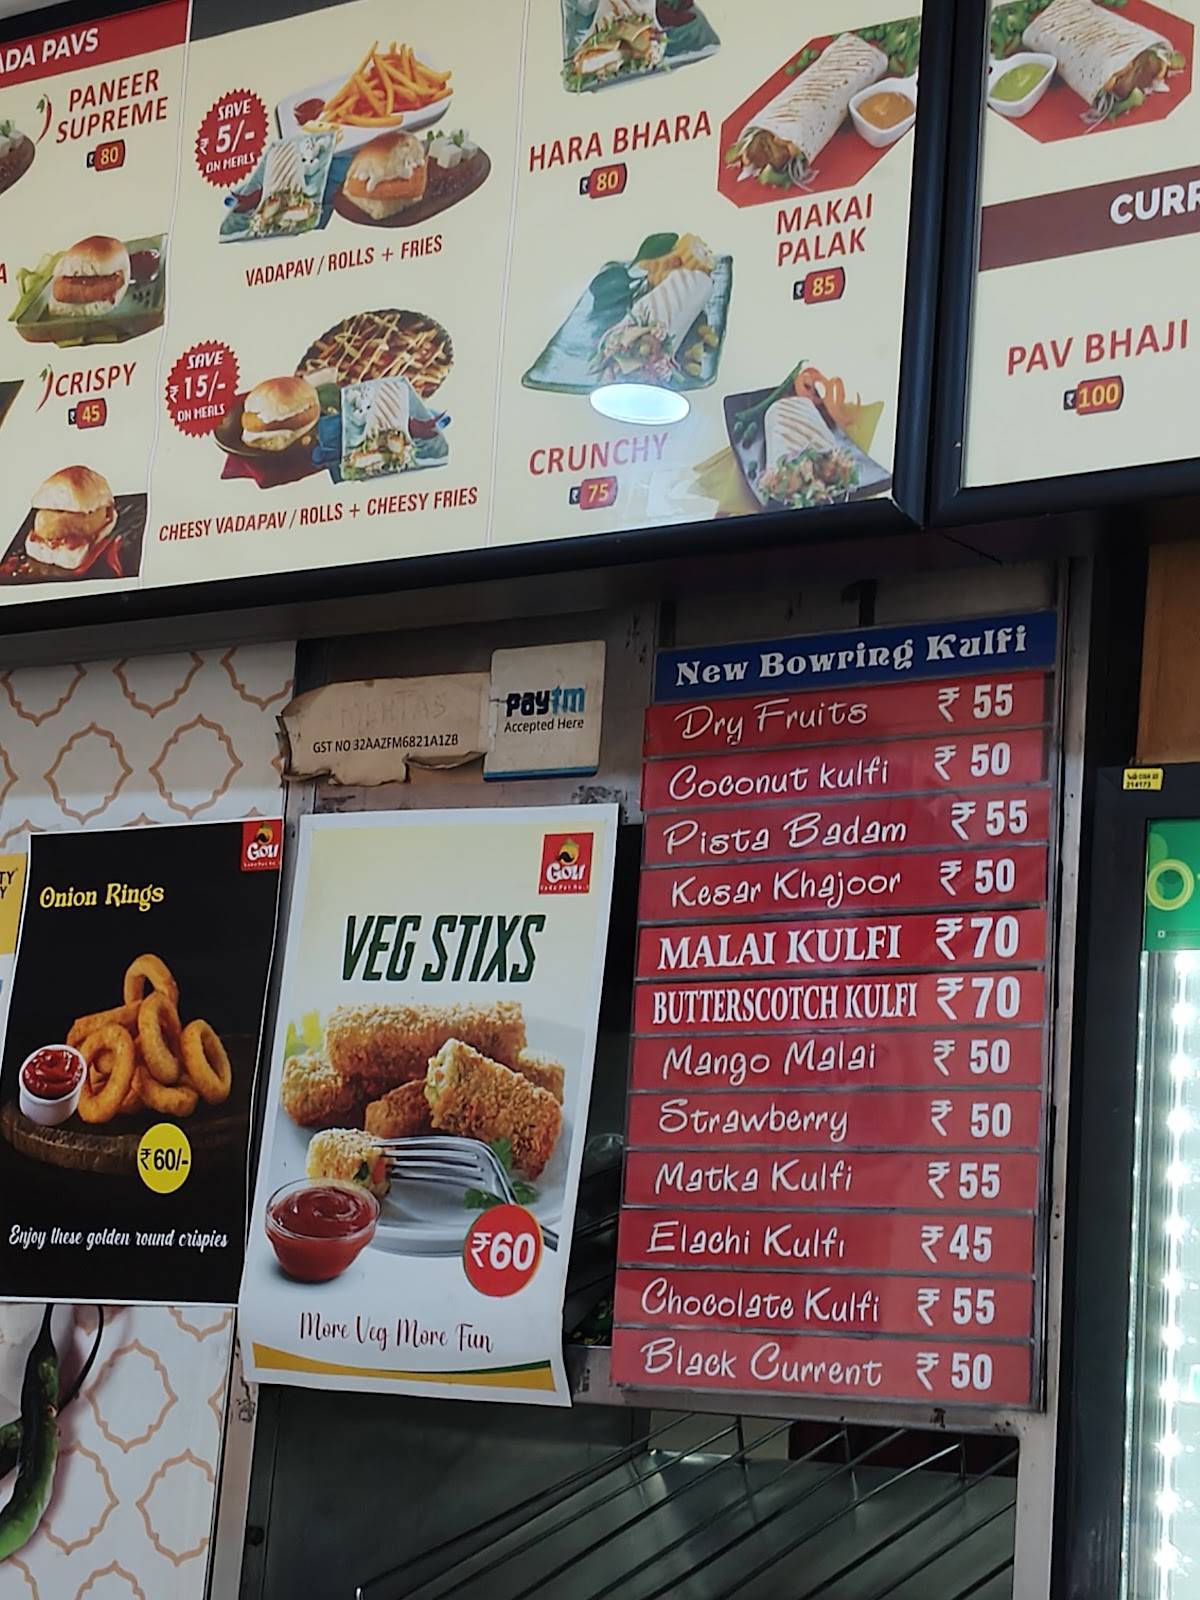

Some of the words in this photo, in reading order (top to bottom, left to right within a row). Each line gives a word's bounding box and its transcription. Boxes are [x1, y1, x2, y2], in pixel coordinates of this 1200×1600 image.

[41, 27, 99, 63] PAVS
[68, 69, 160, 112] PANEER
[217, 98, 252, 121] SAVE
[55, 97, 169, 144] SUPREME
[529, 131, 603, 173] HARA
[612, 110, 712, 154] BHARA
[100, 146, 119, 165] 80
[205, 161, 221, 174] ON
[222, 152, 255, 170] MEALS
[596, 171, 619, 192] 80
[776, 192, 873, 236] MAKAI
[245, 257, 315, 287] VADAPAV
[328, 246, 374, 272] ROLLS
[400, 234, 443, 260] FRIES
[777, 226, 867, 267] PALAK
[812, 275, 836, 297] 85
[186, 350, 224, 370] SAVE
[1007, 337, 1074, 376] PAV
[1085, 318, 1189, 364] BHAJI
[55, 361, 137, 397] CRISPY
[177, 409, 192, 422] ON
[193, 403, 225, 420] MEALS
[529, 432, 669, 476] CRUNCHY
[159, 519, 211, 542] CHEESY
[215, 511, 287, 535] VADAPAV
[300, 502, 343, 526] ROLLS
[367, 493, 429, 516] CHEESY
[433, 486, 479, 510] FRIES
[587, 482, 609, 503] 75
[675, 661, 749, 687] New
[759, 638, 914, 679] Bowring
[926, 624, 1027, 661] Kulfi
[505, 685, 586, 718] paytm
[674, 704, 744, 746] Dry
[753, 698, 868, 733] Fruits
[973, 683, 1014, 720] 55
[503, 713, 554, 735] Accepted
[556, 713, 585, 730] Here
[312, 740, 332, 754] GST
[335, 738, 351, 752] NO
[668, 764, 808, 802] Coconut
[819, 756, 889, 788] kulfi
[970, 742, 1011, 778] 50
[663, 819, 770, 856] Pista
[782, 811, 907, 850] Badam
[985, 799, 1029, 836] 55
[39, 886, 97, 909] Onion
[105, 882, 165, 912] Rings
[671, 876, 762, 909] Kesar
[772, 867, 902, 910] Khajoor
[974, 858, 1016, 895] 50
[342, 915, 422, 981] VEG
[421, 914, 546, 982] STIXS
[657, 931, 777, 971] MALAI
[786, 925, 903, 965] KULFI
[652, 984, 839, 1025] BUTTERSCOTCH
[844, 982, 918, 1020] KULFI
[662, 1041, 770, 1087] Mango
[783, 1039, 877, 1076] Malai
[969, 1038, 1011, 1075] 50
[658, 1099, 849, 1143] Strawberry
[970, 1102, 1012, 1139] 50
[654, 1160, 760, 1195] Matka
[771, 1158, 853, 1193] Kulfi
[9, 1224, 47, 1250] Enjoy
[50, 1227, 83, 1246] these
[86, 1228, 130, 1250] golden
[135, 1229, 176, 1247] round
[178, 1229, 229, 1253] crispies
[645, 1220, 752, 1255] Elachi
[640, 1276, 795, 1319] Chocolate
[804, 1286, 881, 1323] Kulfi
[951, 1286, 996, 1326] 55
[299, 1311, 350, 1341] More
[356, 1315, 389, 1352] Veg
[396, 1317, 448, 1348] More
[456, 1322, 494, 1353] Fun
[639, 1337, 738, 1380] Black
[749, 1342, 883, 1388] Current
[950, 1351, 993, 1390] 50
